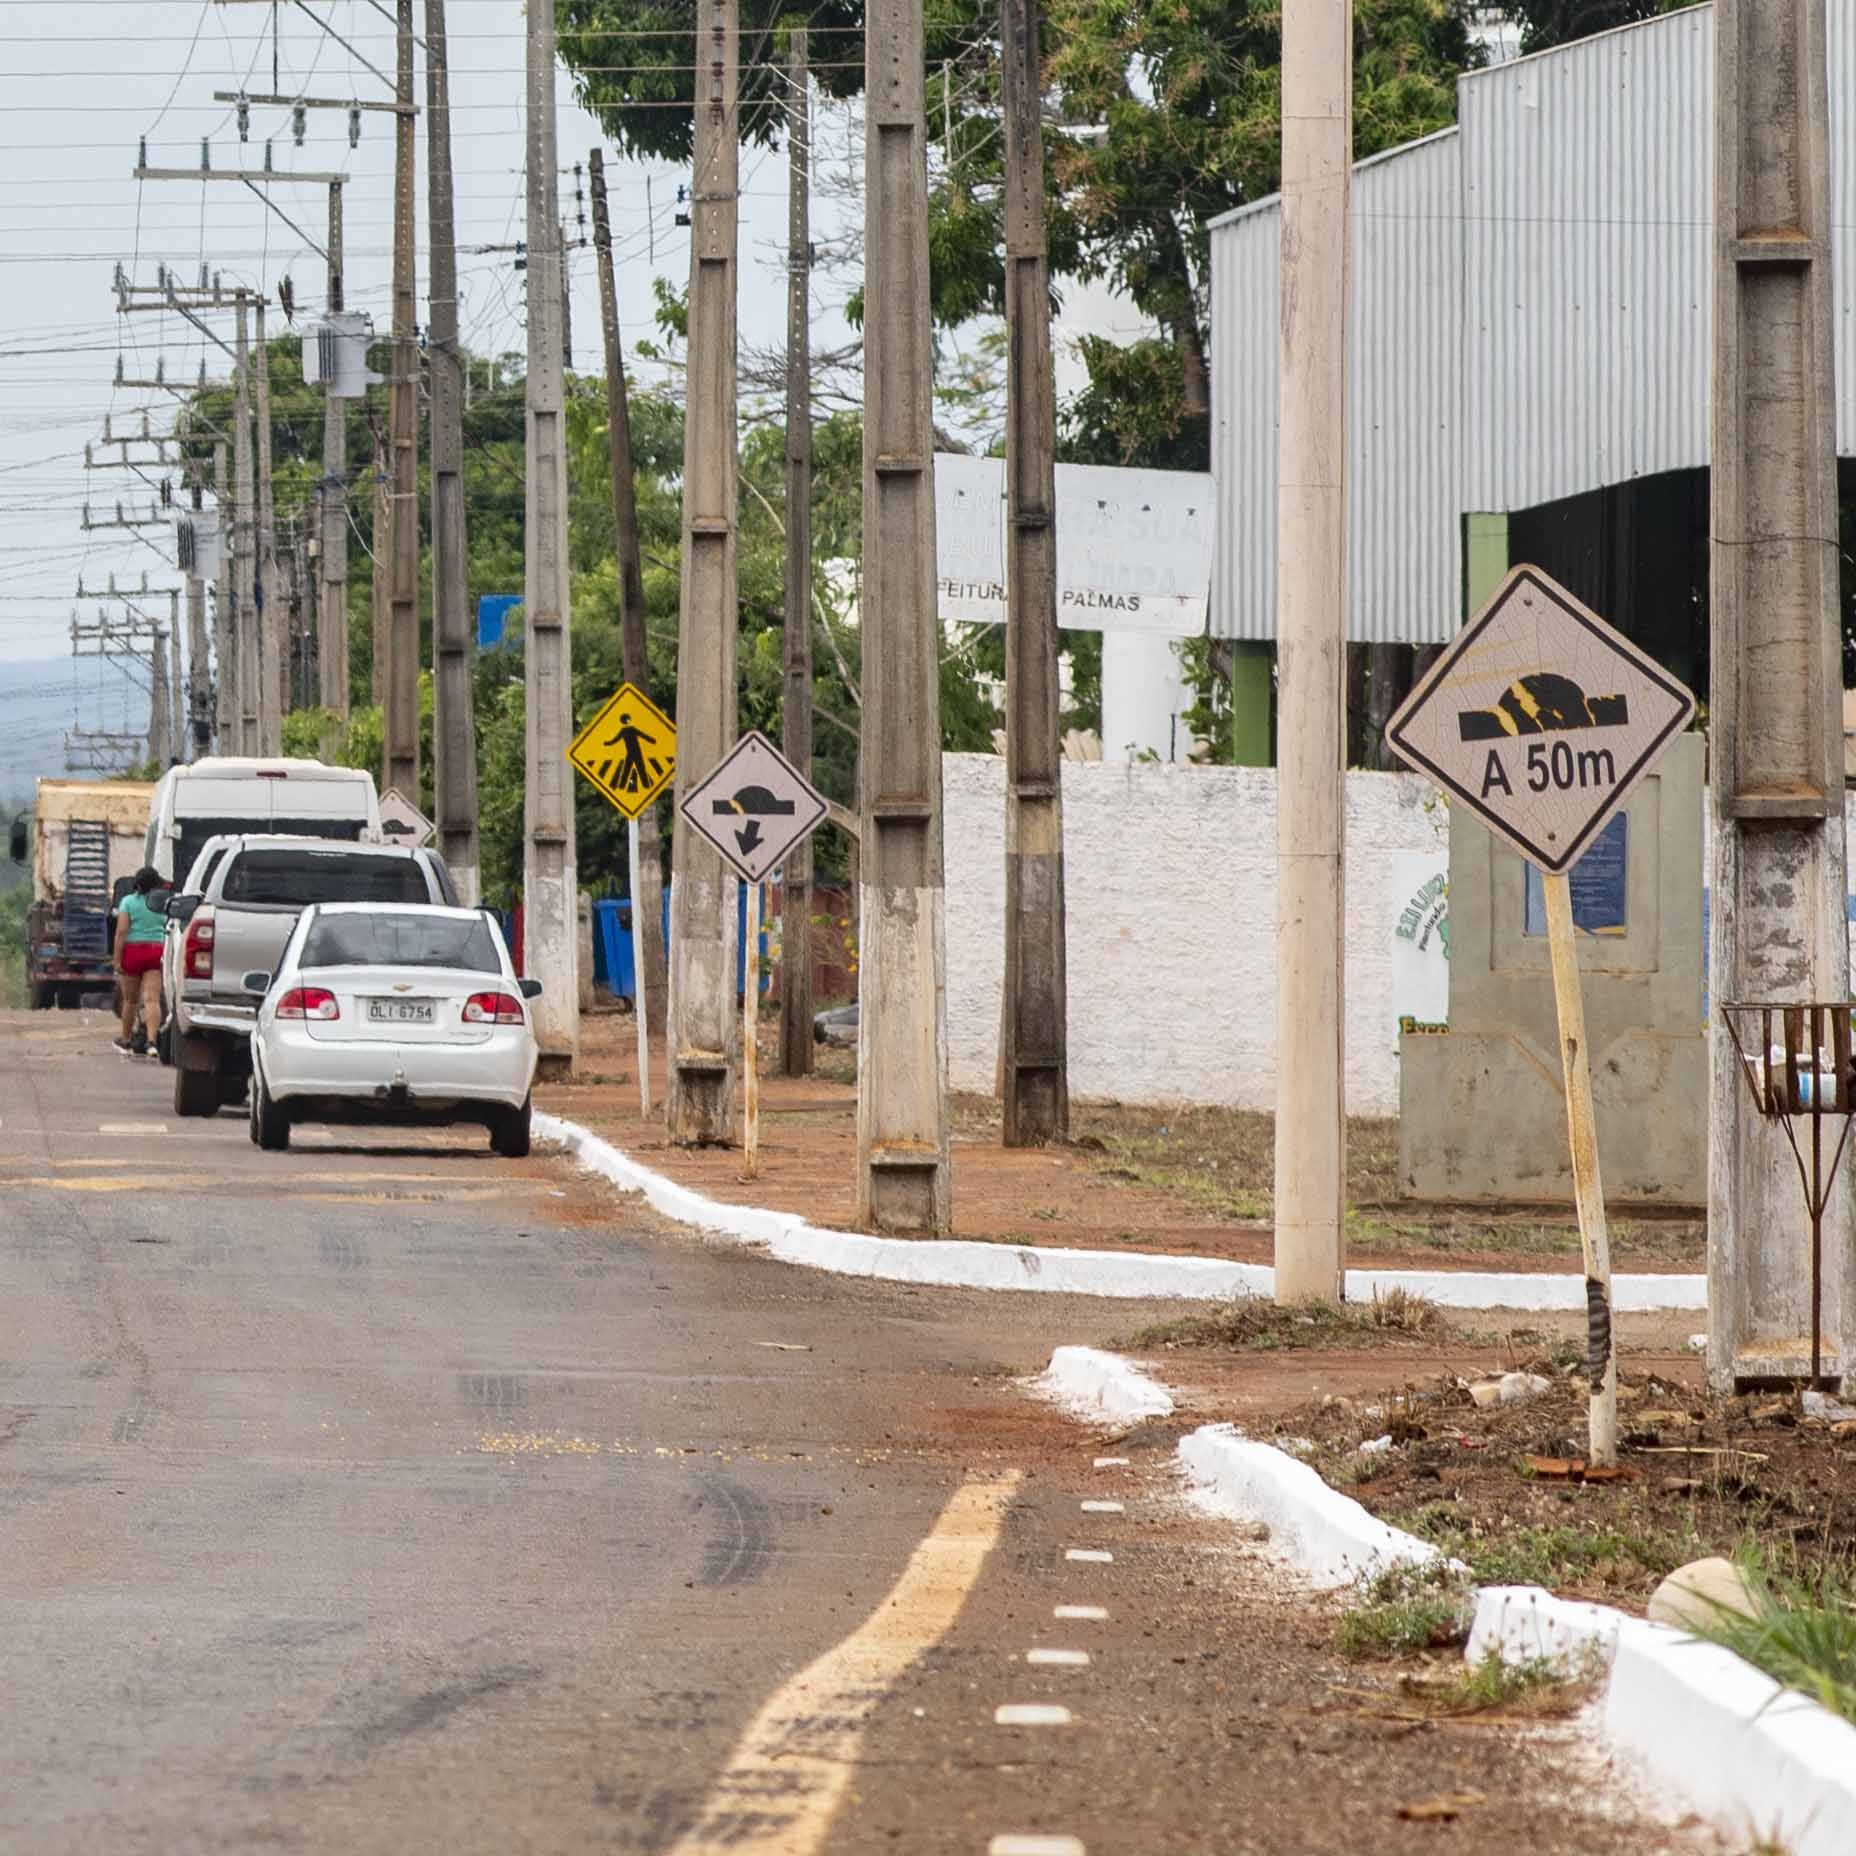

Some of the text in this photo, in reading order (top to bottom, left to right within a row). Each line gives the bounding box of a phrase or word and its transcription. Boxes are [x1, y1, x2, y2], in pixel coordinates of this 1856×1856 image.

[1062, 590, 1141, 612] PALMAS
[1480, 740, 1617, 799] A 50m
